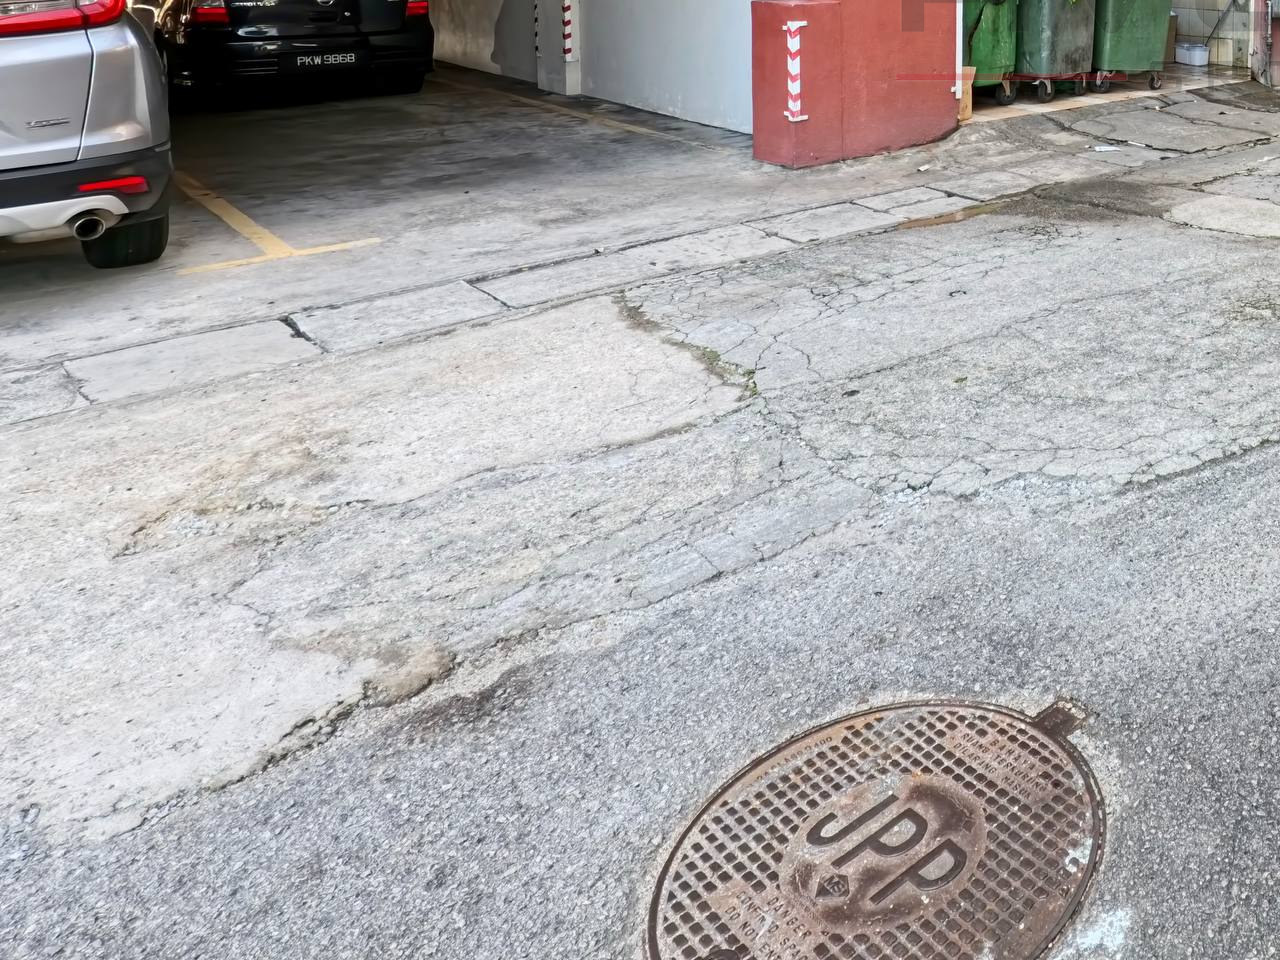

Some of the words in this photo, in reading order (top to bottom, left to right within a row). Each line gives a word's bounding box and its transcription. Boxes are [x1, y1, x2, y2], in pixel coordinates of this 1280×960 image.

[296, 55, 322, 66] PKW
[953, 742, 998, 774] DILARANG
[961, 733, 990, 754] RUANG
[989, 739, 1036, 771] BAHAYA
[806, 793, 967, 905] JPP
[725, 906, 741, 921] DO
[736, 891, 779, 934] CONFIND
[766, 896, 812, 940] DANGER
